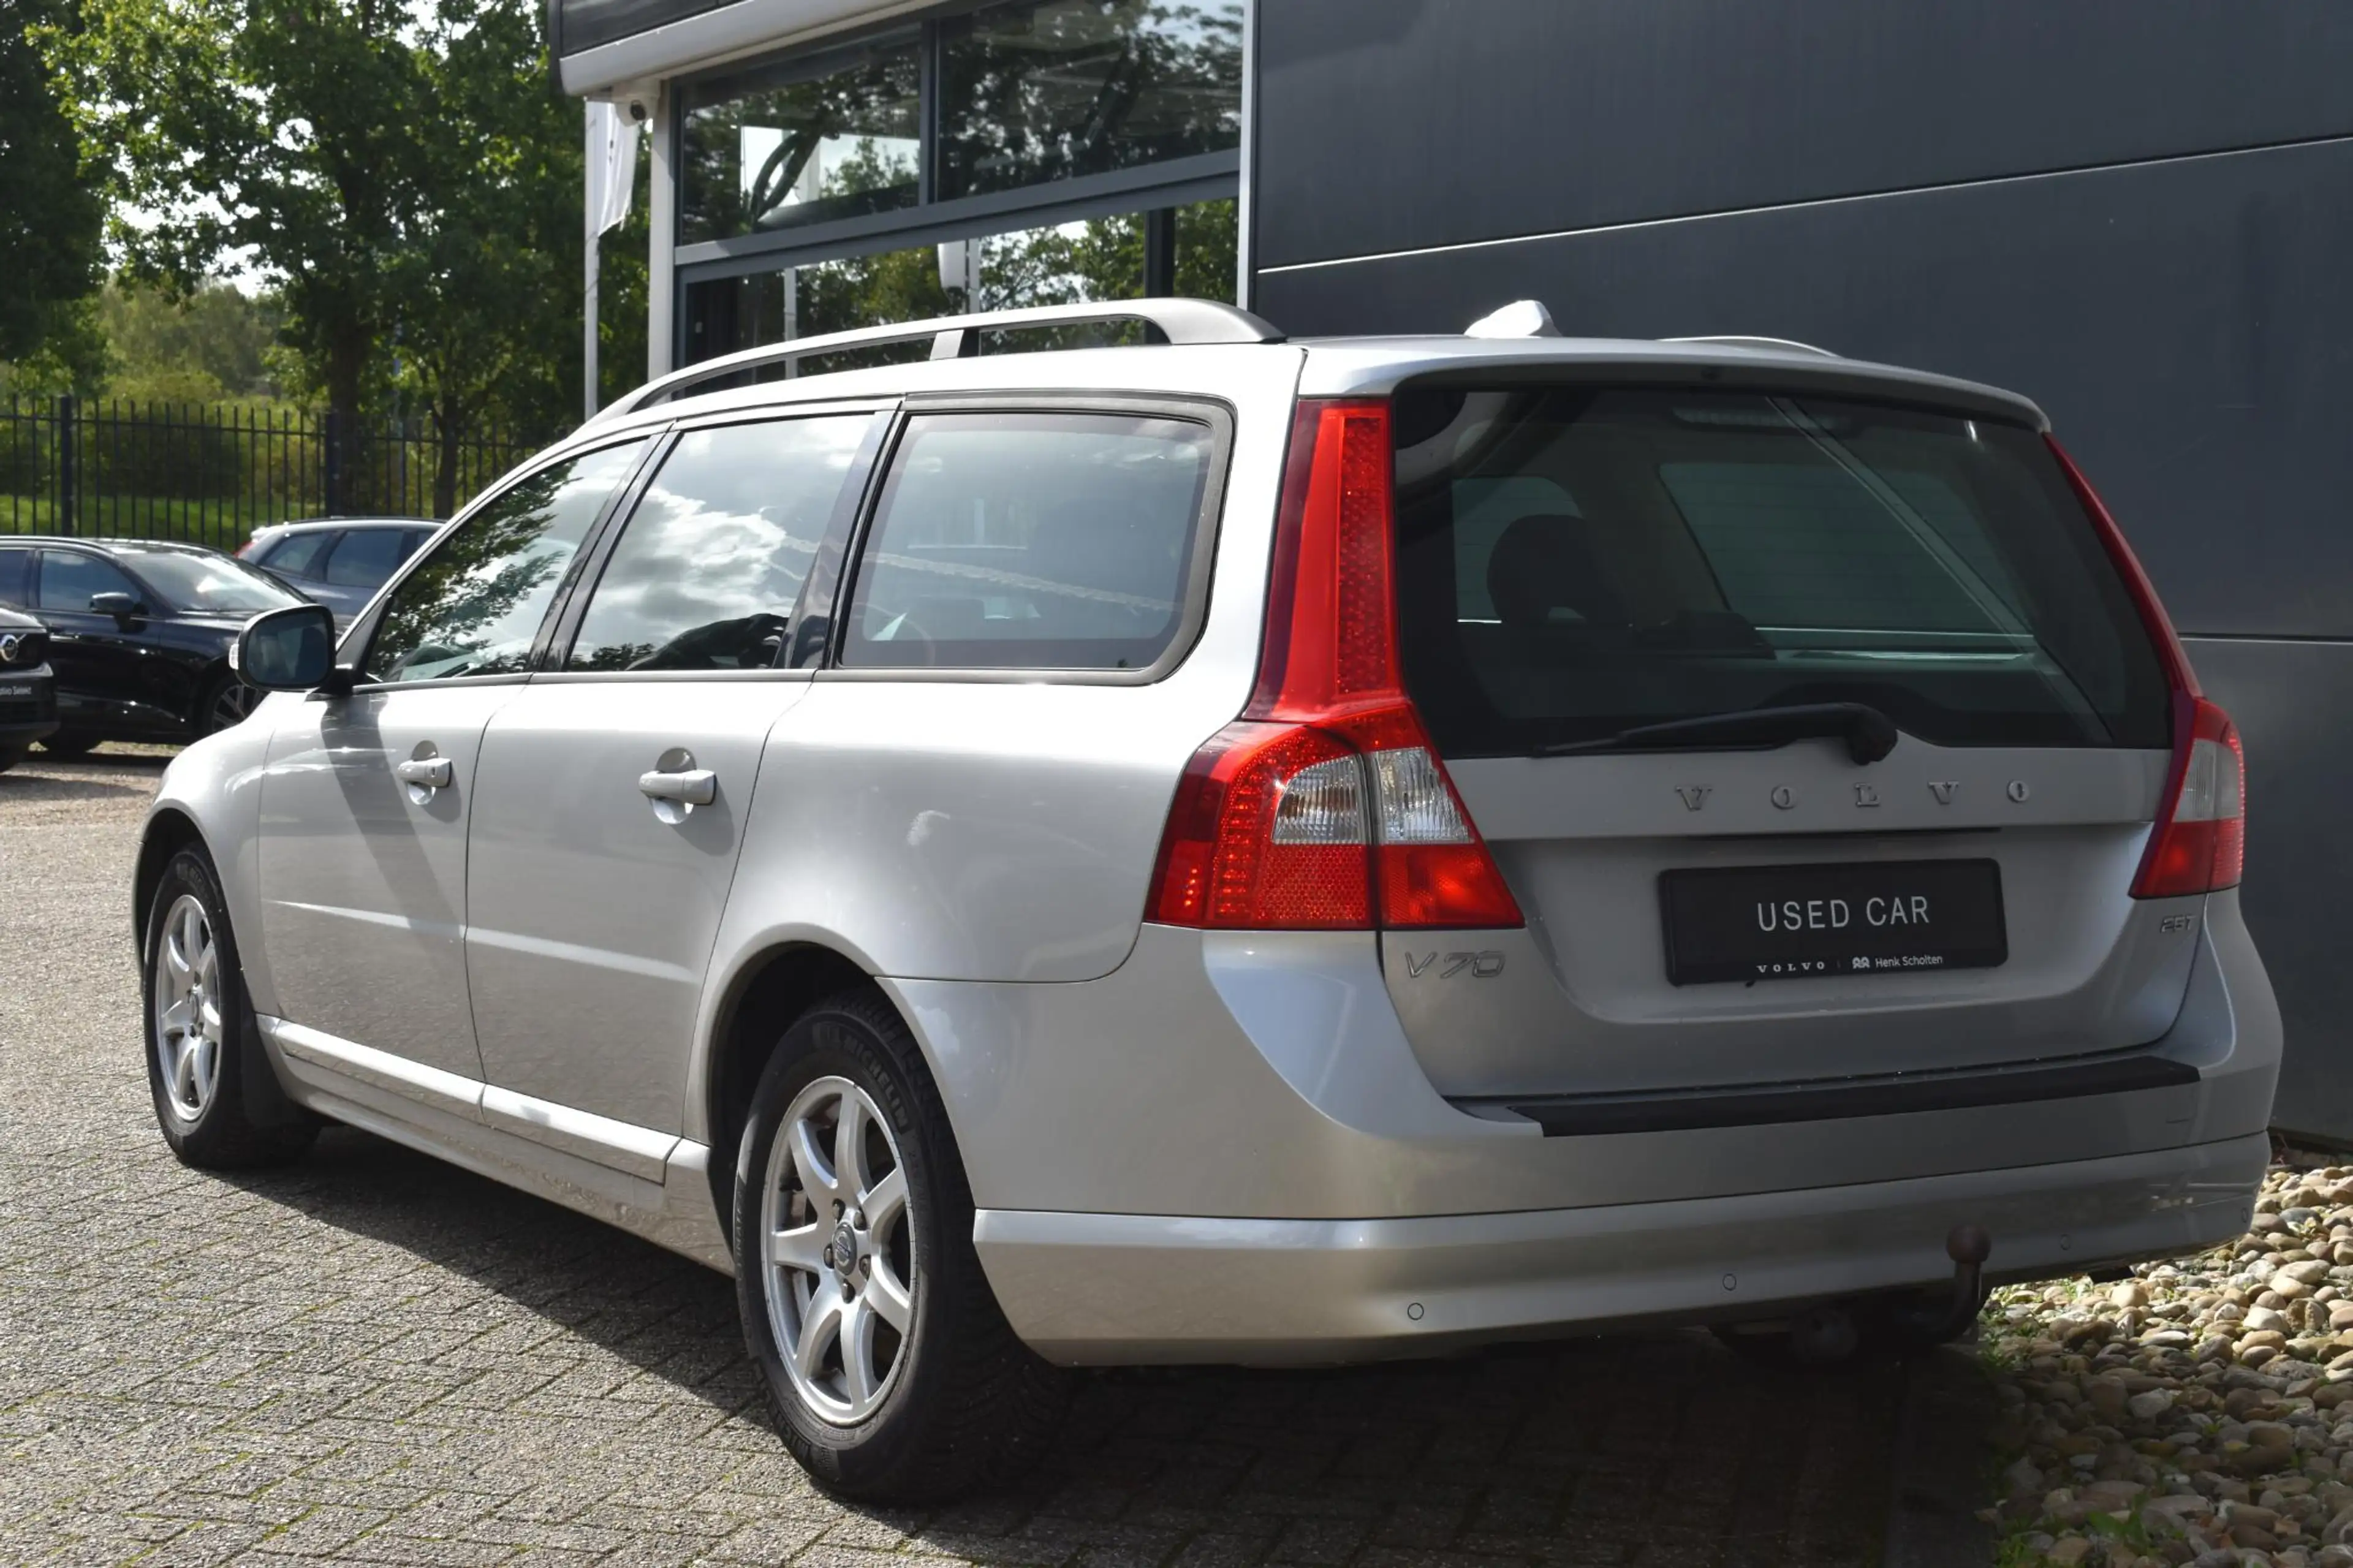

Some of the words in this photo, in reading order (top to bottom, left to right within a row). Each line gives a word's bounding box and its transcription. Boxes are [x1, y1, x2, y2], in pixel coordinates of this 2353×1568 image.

[1675, 779, 2031, 811] VOLVO
[1757, 899, 1850, 931] USED
[1866, 895, 1930, 925] CAR
[1404, 950, 1507, 979] V70
[1756, 961, 1825, 973] VOLVO
[1875, 957, 1900, 968] Henk
[1902, 955, 1943, 967] Scholten
[843, 1034, 909, 1129] MICHELIN
